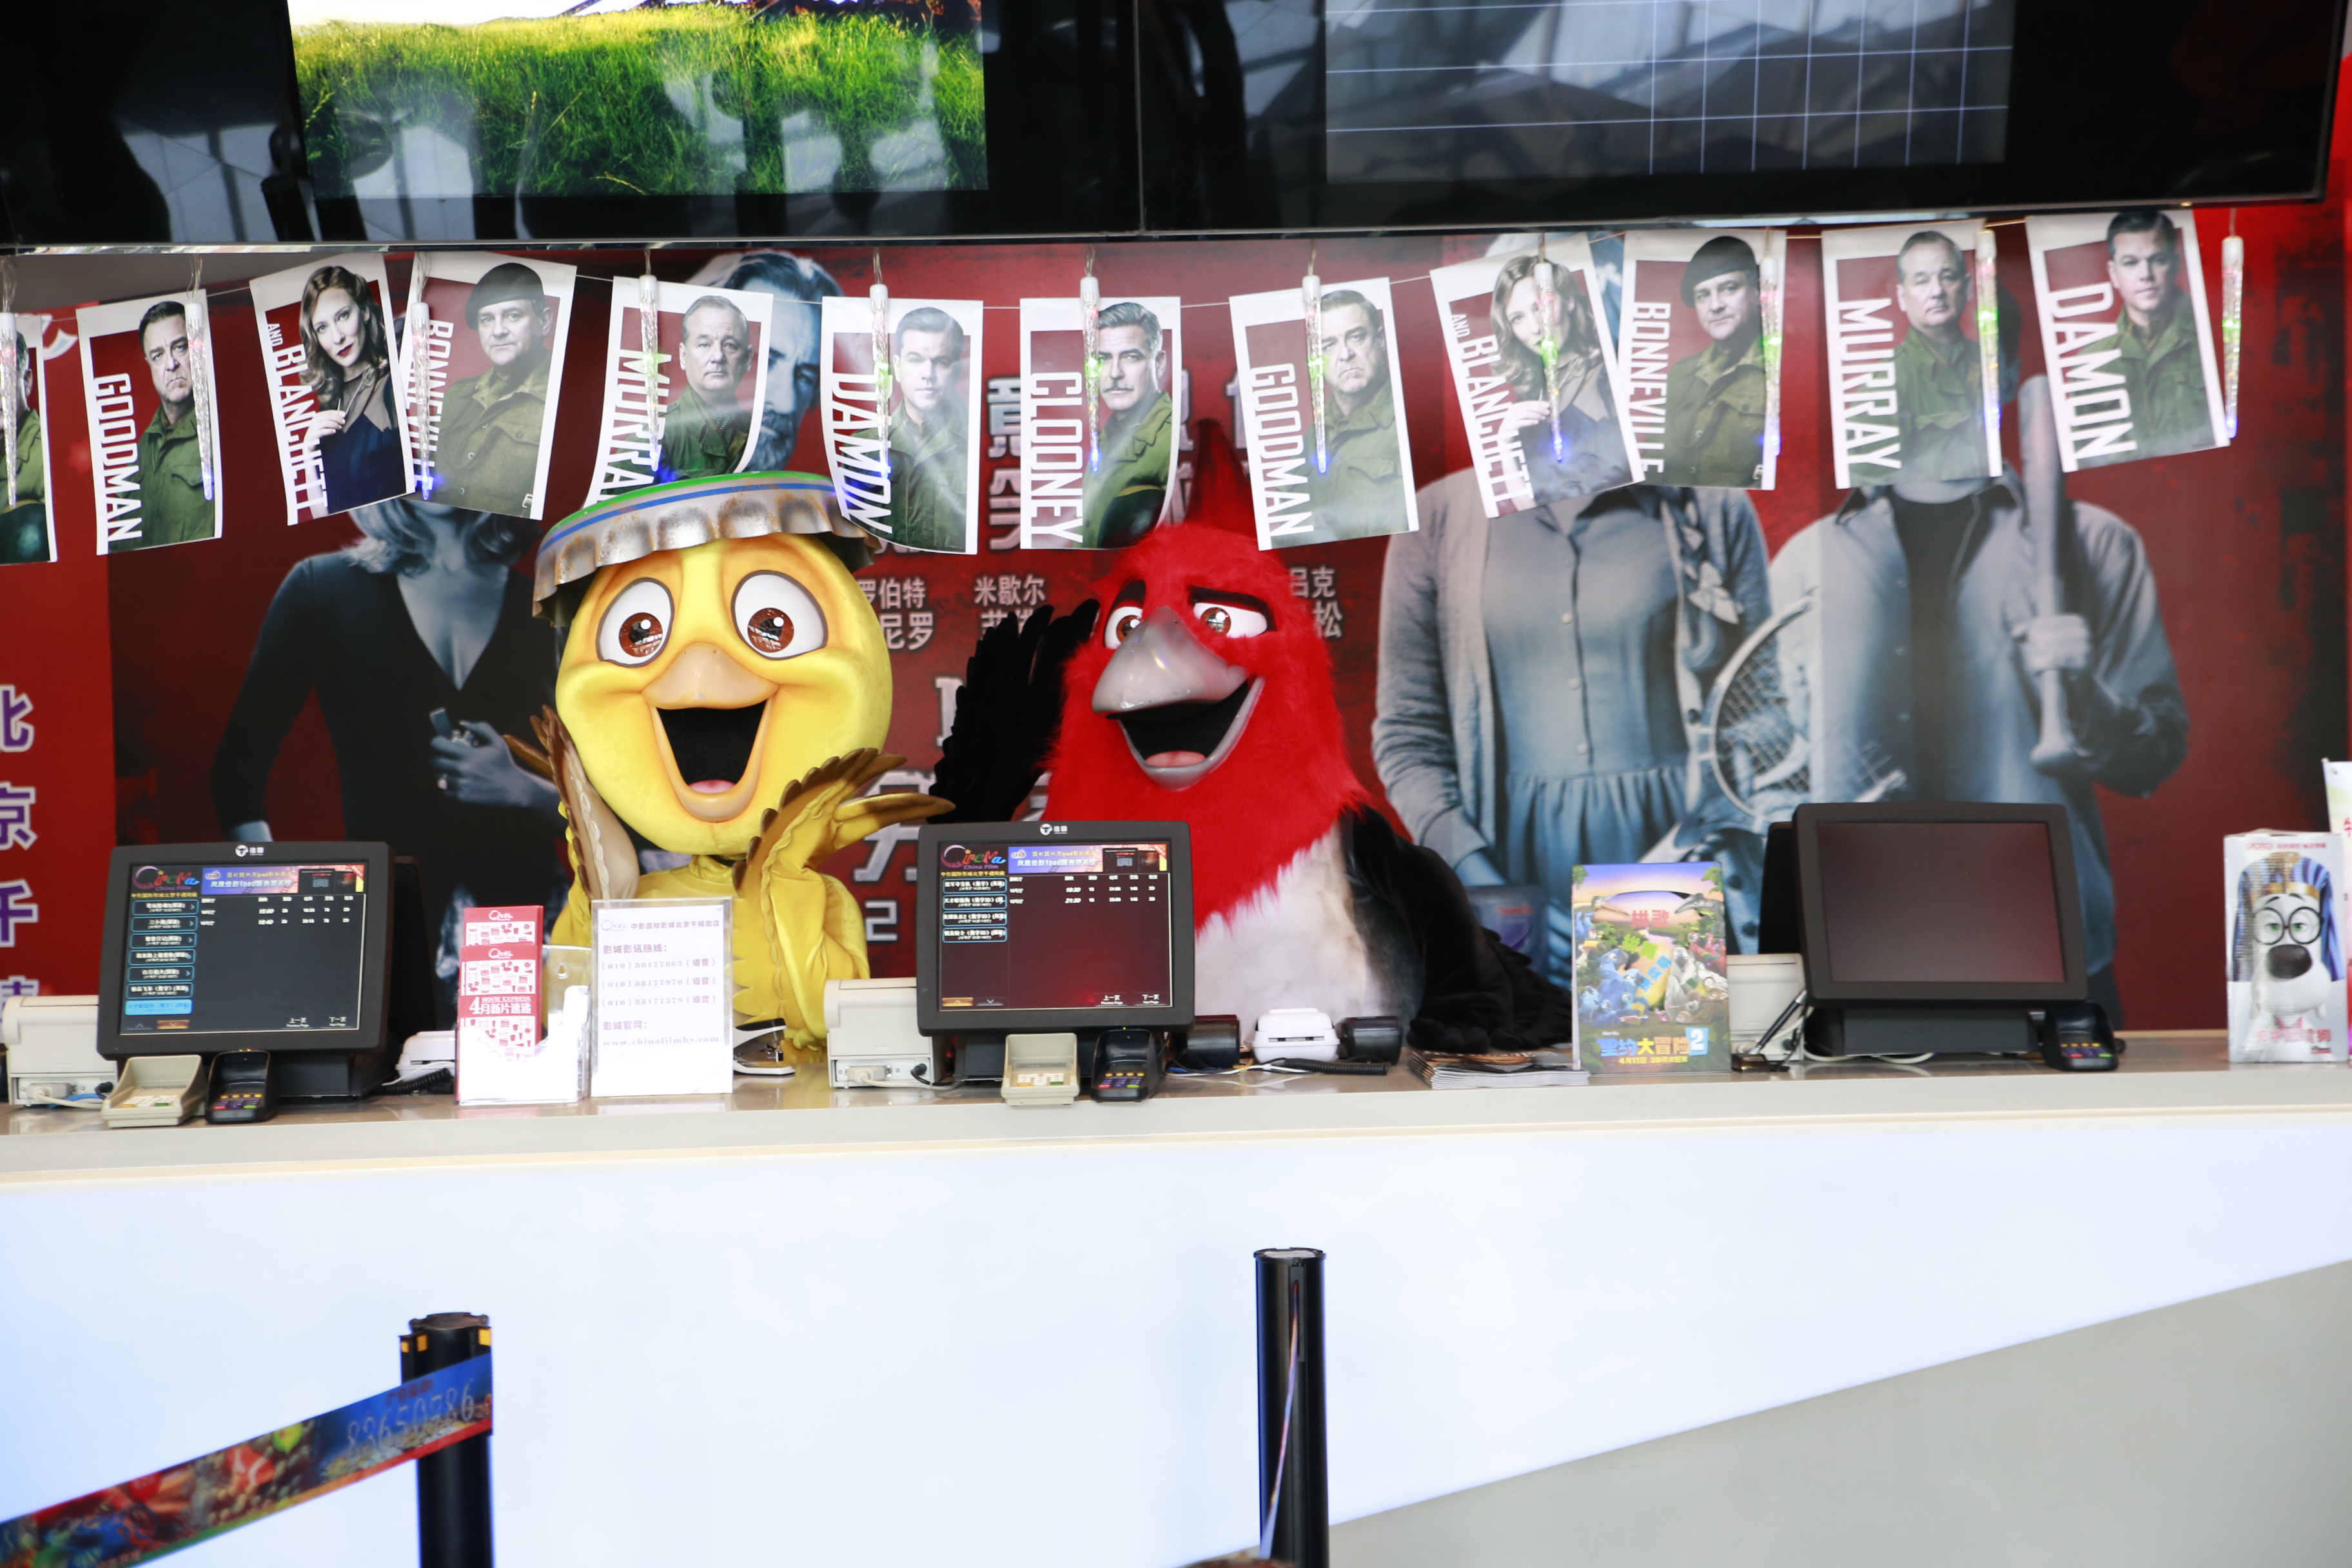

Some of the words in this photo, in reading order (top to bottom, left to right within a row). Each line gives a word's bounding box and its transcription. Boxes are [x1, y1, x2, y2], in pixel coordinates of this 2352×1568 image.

[266, 322, 284, 347] AND
[1451, 314, 1471, 338] AND
[1462, 335, 1534, 501] BLANCHETT
[1629, 301, 1671, 473] BONNEVILLE
[1838, 297, 1901, 468] MURRAY
[2048, 283, 2137, 460] DAMON
[94, 373, 142, 542] GOODMAN
[273, 344, 328, 512] BLANCHETT
[598, 349, 672, 503] MURRA
[832, 373, 893, 534] DAMON
[1030, 371, 1084, 543] CLOONEY
[1250, 363, 1314, 536] GOODMAN
[974, 574, 1046, 607] 米歇尔
